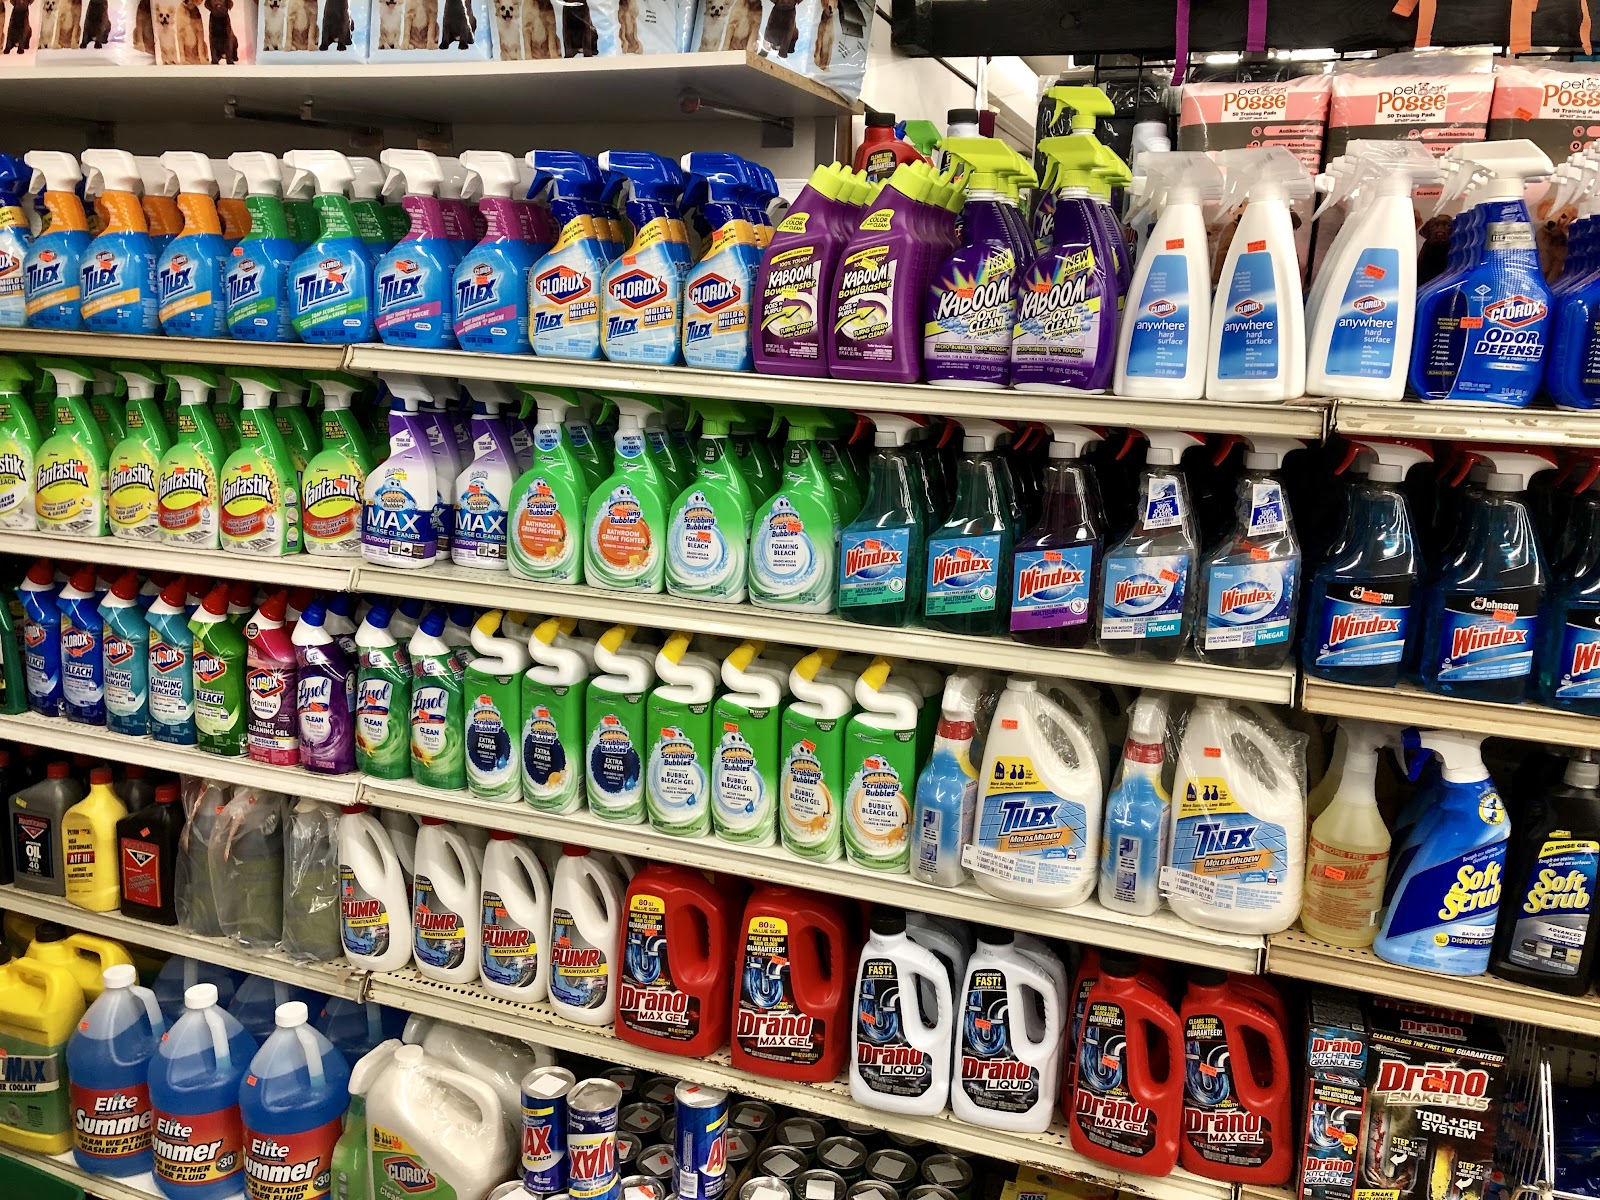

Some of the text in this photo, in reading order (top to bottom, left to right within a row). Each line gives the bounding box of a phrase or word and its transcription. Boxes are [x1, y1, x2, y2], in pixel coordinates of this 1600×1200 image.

[1394, 86, 1417, 96] pet
[1223, 93, 1286, 111] Posse
[1378, 92, 1446, 112] Posse
[27, 263, 63, 297] TILEX
[769, 264, 813, 286] KABOOM
[843, 264, 889, 290] KABOOM
[540, 272, 586, 296] CLOROX
[613, 276, 662, 300] CLOROX
[692, 279, 736, 303] CLOROX
[838, 280, 891, 298] BowlBlaster
[298, 272, 349, 311] TILEX
[379, 274, 422, 312] TILEX
[456, 276, 497, 318] TILEX
[937, 278, 1012, 319] KABOOM
[645, 307, 663, 315] MOLD
[1151, 303, 1176, 314] CLOROX
[1357, 299, 1384, 310] CLOROX
[570, 307, 597, 317] MILDEW
[645, 312, 673, 322] MILDEW
[977, 310, 1000, 322] OXI
[1490, 302, 1541, 322] CLOROX
[607, 317, 638, 341] TILEX
[968, 317, 1003, 333] CLEAN
[1137, 320, 1186, 334] anywhere
[1339, 317, 1394, 331] anywhere
[1364, 336, 1390, 344] surface
[1485, 329, 1539, 344] ODOR
[1475, 343, 1543, 357] DEFENSE
[37, 460, 89, 492] fantastik
[160, 467, 209, 501] fantastik
[223, 477, 273, 508] fantastik
[305, 476, 362, 511] fantastik
[527, 502, 557, 512] Scrubbing
[528, 509, 553, 517] Bubbles
[368, 509, 422, 533] MAX
[526, 521, 556, 529] BATHROOM
[684, 516, 715, 526] Scrubbing
[686, 523, 712, 531] Bubbles
[367, 525, 420, 540] GREASE CLEANER
[521, 525, 561, 536] GRIME FIGHTER
[846, 548, 902, 579] Windex
[933, 556, 993, 587] Windex
[1020, 566, 1085, 601] Windex
[1115, 582, 1167, 606] Windex
[1220, 589, 1276, 615] Windex
[1482, 600, 1519, 612] Johnson
[1147, 625, 1175, 633] VINEGAR
[1329, 614, 1400, 646] Windex
[1452, 628, 1528, 660] Windex
[65, 666, 93, 678] BLEACH
[194, 658, 221, 674] CLOROX
[151, 676, 182, 689] CLINGING
[151, 684, 182, 697] BLEACH GEL
[299, 679, 328, 705] Lysol
[196, 692, 224, 704] BLEACH
[250, 698, 277, 711] Scentiva
[413, 690, 444, 712] Lysol
[255, 720, 275, 729] TOILET
[306, 715, 324, 724] CLEAN
[248, 725, 289, 736] CLEANING GEL
[420, 727, 440, 736] CLEAN
[599, 739, 630, 749] Scrubbing
[603, 763, 624, 772] POWER
[604, 758, 623, 766] EXTRA
[862, 782, 900, 792] Scrubbing
[865, 788, 896, 797] Bubbles
[862, 808, 885, 817] BLEACH
[868, 802, 893, 811] BUBBLY
[1000, 800, 1060, 834] TILEX
[1194, 823, 1260, 858] TILEX
[26, 845, 42, 859] OIL
[70, 854, 82, 864] ATF
[1454, 861, 1502, 890] Soft
[1536, 869, 1588, 894] Soft
[1439, 884, 1501, 920] Scrub
[1523, 890, 1590, 913] Scrub
[414, 913, 457, 930] PLUMR
[1548, 926, 1582, 937] ADVANCED
[1554, 933, 1581, 942] SURFACE
[746, 945, 785, 954] GUARANTEED!
[551, 949, 600, 967] PLUMR
[868, 965, 892, 976] FAST!
[976, 976, 1001, 987] FAST!
[639, 1011, 687, 1024] MAX GEL
[1187, 1028, 1223, 1037] GUARANTEED!
[759, 1036, 812, 1048] MAX GEL
[1373, 1033, 1393, 1041] CLEARS
[1424, 1042, 1441, 1050] FIRST
[1442, 1045, 1455, 1053] TIME
[1456, 1048, 1504, 1062] GUARANTEED!
[1311, 1052, 1351, 1060] KITCHEN
[881, 1065, 926, 1075] LIQUID
[1310, 1059, 1364, 1069] GRANULES
[987, 1080, 1034, 1090] LIQUID
[94, 1094, 138, 1112] Elite
[1391, 1091, 1489, 1110] SNAKE PLUS
[157, 1118, 193, 1137] Elite
[1416, 1110, 1484, 1132] TOOL+GEL
[1421, 1122, 1476, 1140] SYSTEM
[1393, 1137, 1418, 1148] STEP 1:
[166, 1164, 210, 1173] WEATHER
[388, 1162, 432, 1184] CLOROX
